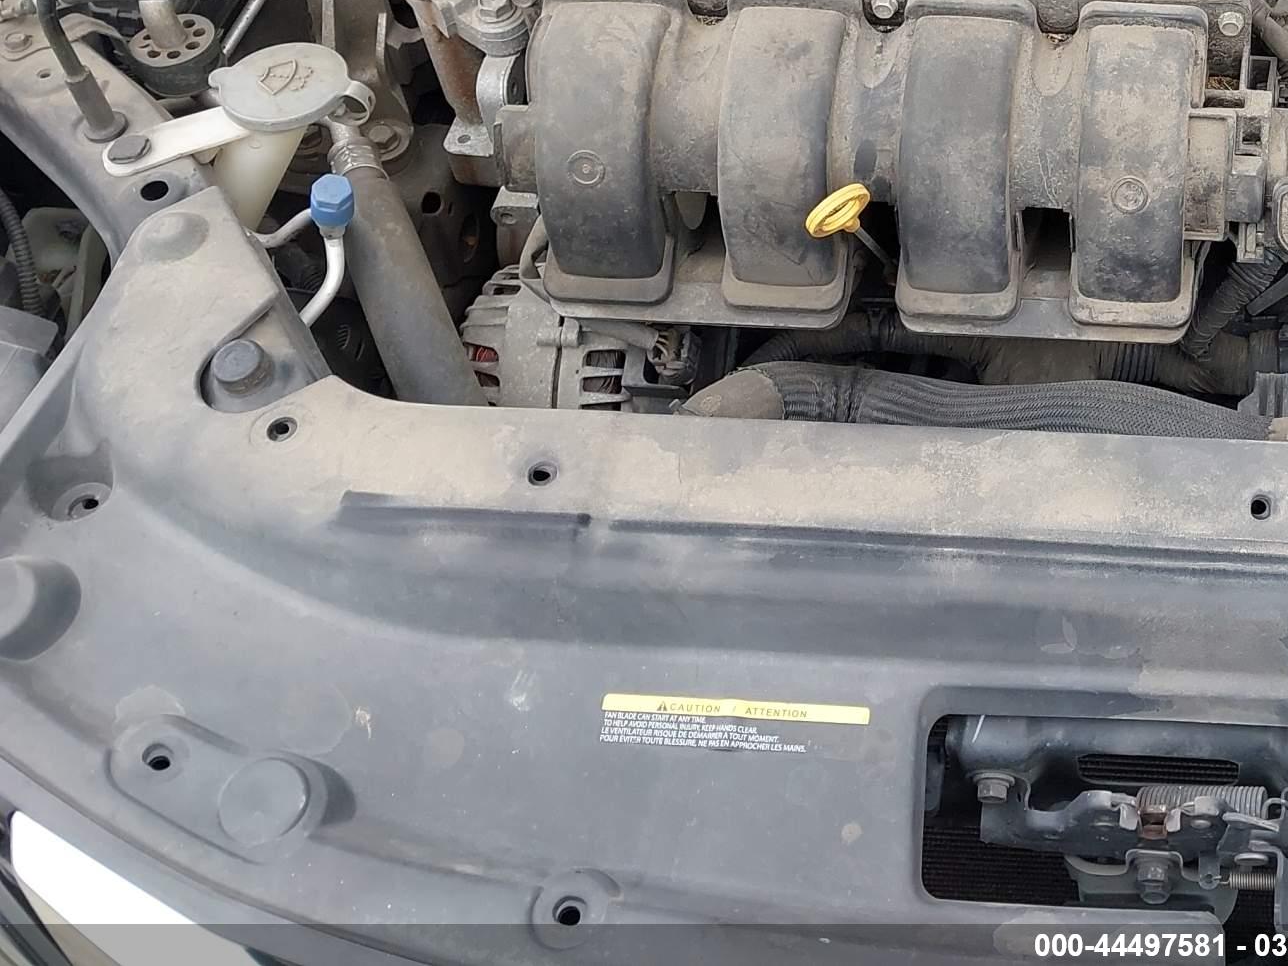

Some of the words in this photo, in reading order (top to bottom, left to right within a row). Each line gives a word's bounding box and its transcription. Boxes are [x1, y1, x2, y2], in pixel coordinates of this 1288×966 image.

[650, 714, 670, 722] START
[669, 703, 721, 713] CAUTION
[745, 708, 808, 719] ATTENTION
[609, 727, 653, 736] VENTILATEUR
[653, 729, 678, 737] RISQUE
[729, 733, 747, 741] TOUT
[647, 722, 679, 730] PERSONAL
[701, 724, 716, 732] KEEP
[716, 724, 737, 732] HANDS
[641, 737, 664, 745] TOUTE
[719, 740, 730, 748] EN
[730, 741, 770, 751] APPROCHER
[770, 743, 783, 752] LES
